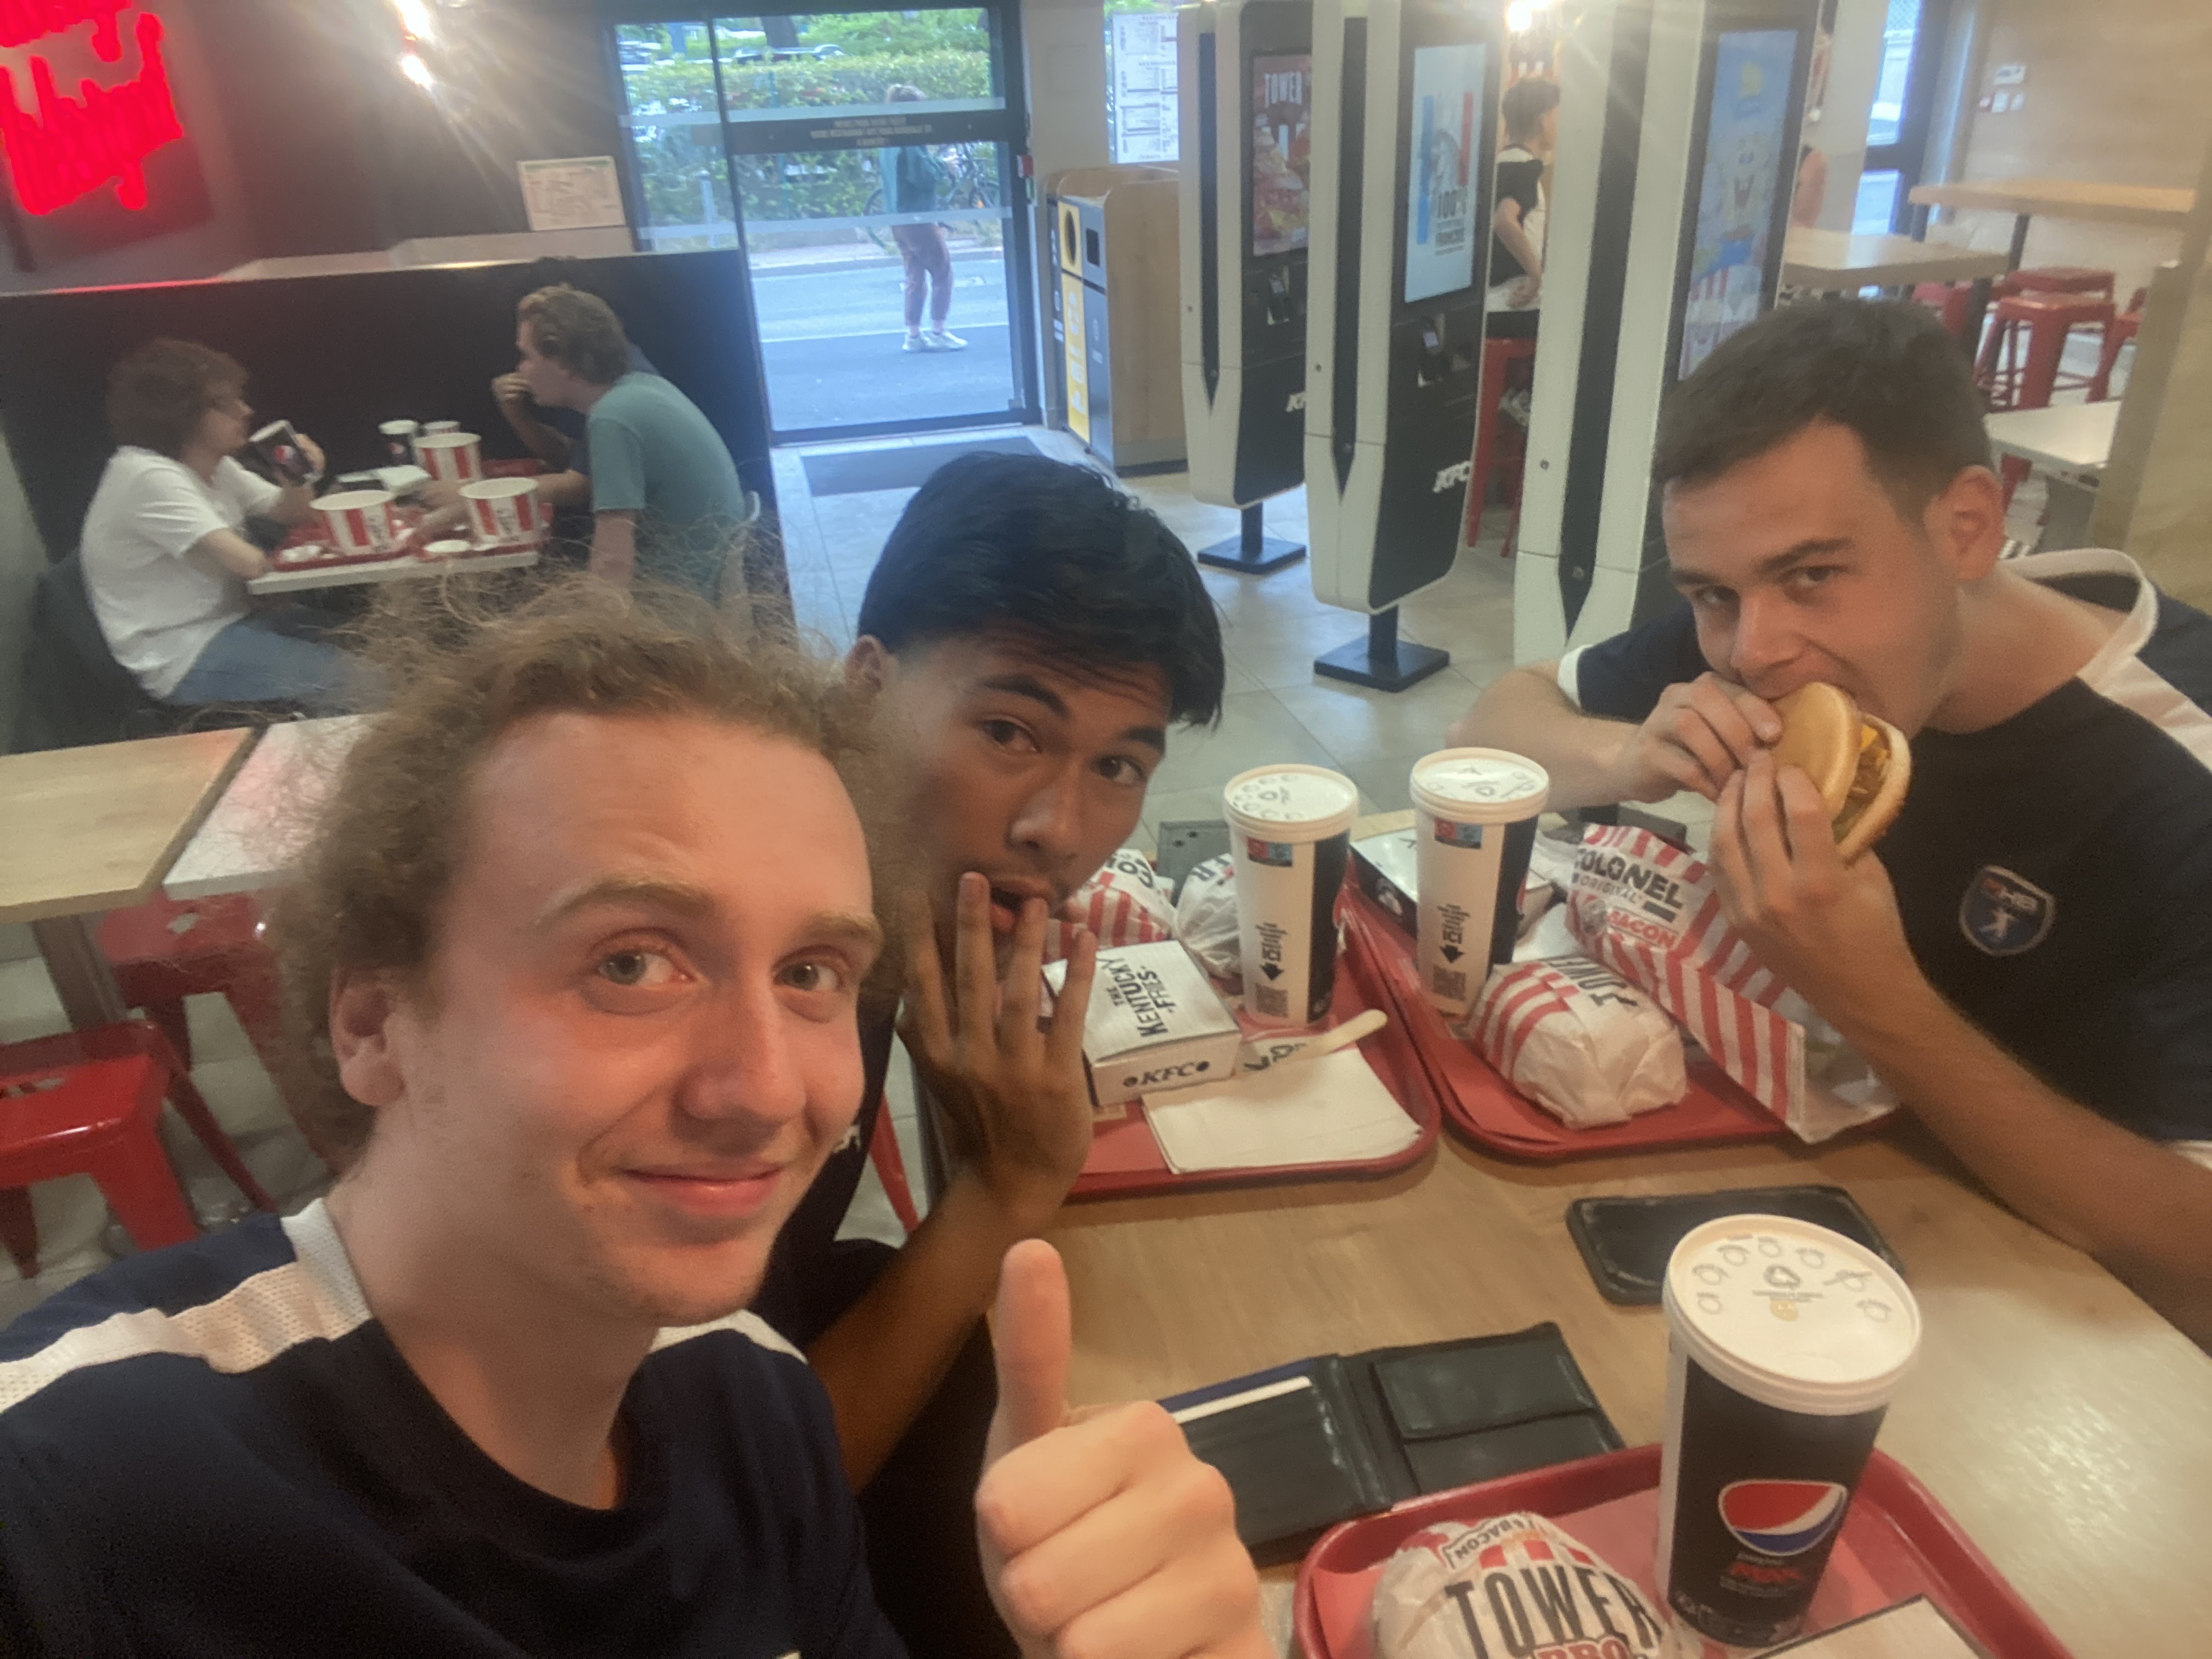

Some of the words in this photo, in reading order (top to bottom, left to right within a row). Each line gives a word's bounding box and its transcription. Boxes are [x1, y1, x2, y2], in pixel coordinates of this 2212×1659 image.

[1286, 392, 1306, 412] KF
[1607, 911, 1675, 949] BACON
[1098, 958, 1168, 1037] KENTUCKY
[1141, 1062, 1194, 1085] KFC
